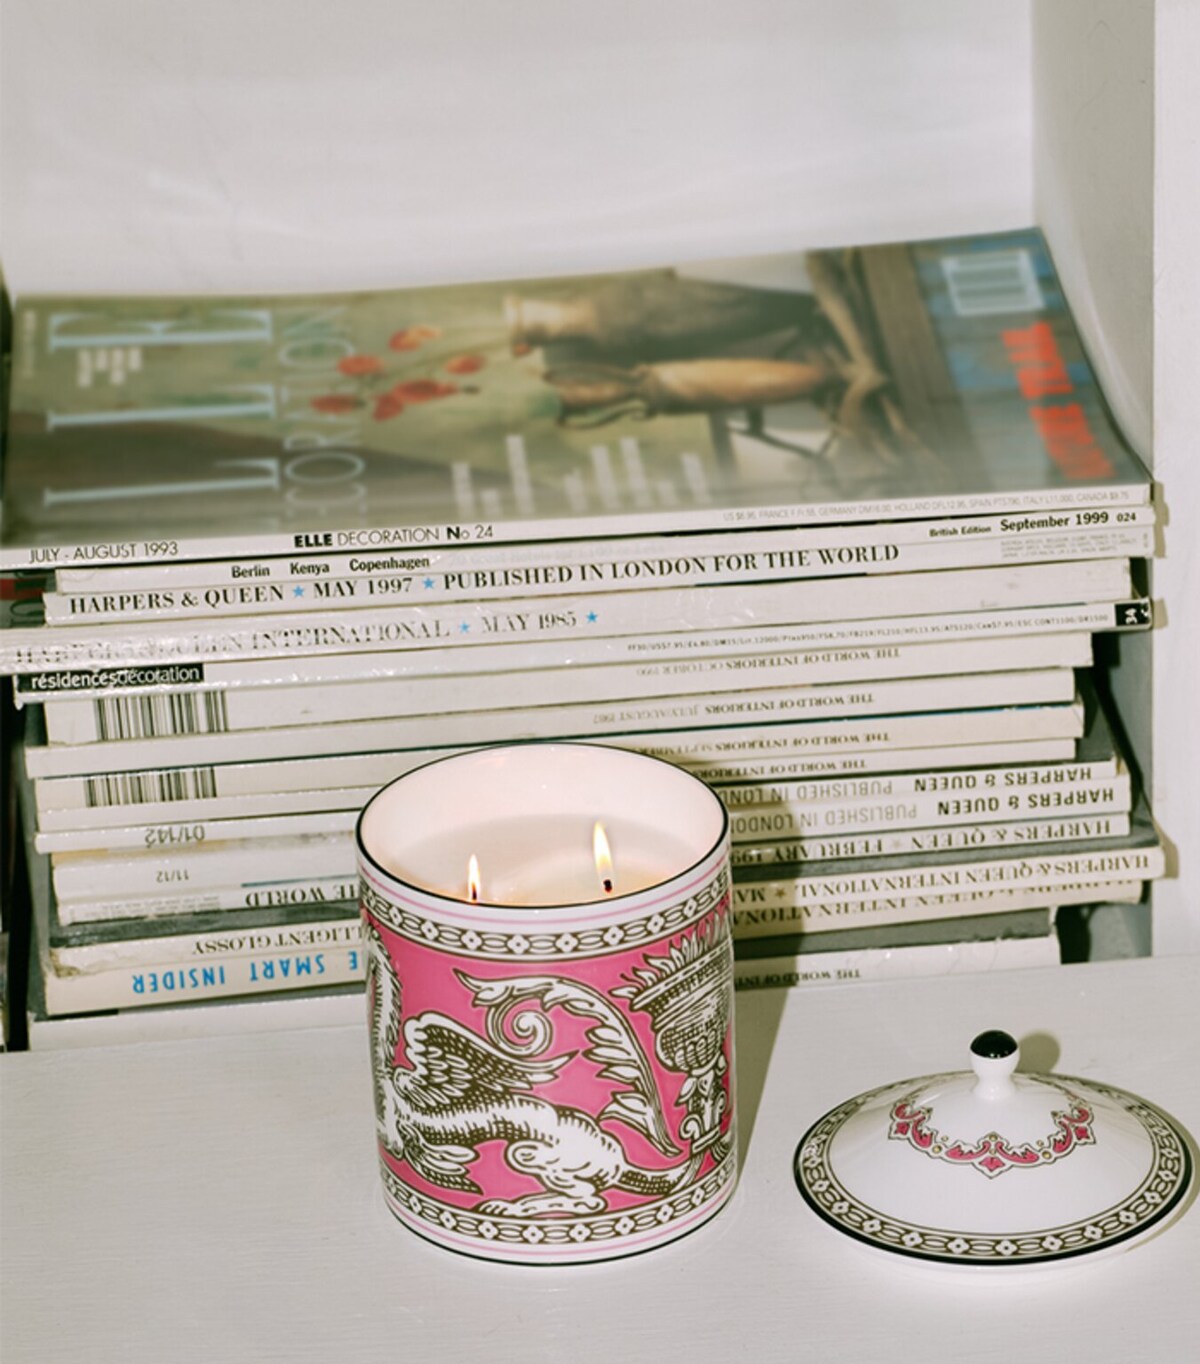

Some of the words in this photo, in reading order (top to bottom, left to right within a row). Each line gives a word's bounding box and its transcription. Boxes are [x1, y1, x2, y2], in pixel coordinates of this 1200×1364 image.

[929, 527, 958, 537] British
[960, 526, 991, 534] Edition
[1000, 515, 1069, 531] September
[1075, 511, 1108, 525] 1999
[1116, 512, 1136, 522] 024
[293, 533, 333, 548] ELLE
[337, 527, 439, 545] DECORATION
[445, 525, 470, 539] No
[474, 525, 493, 539] 24
[28, 546, 60, 563] JULY
[72, 542, 136, 561] AUGUST
[143, 540, 179, 557] 1993
[231, 565, 270, 578] Berlin
[289, 562, 329, 575] Kenya
[349, 556, 429, 572] Copenhagen
[70, 592, 175, 613] HARPERS
[180, 592, 198, 607] &
[204, 584, 283, 608] QUEEN
[314, 580, 356, 597] MAY
[368, 577, 413, 594] 1997
[443, 565, 573, 589] PUBLISHED
[580, 563, 603, 580] IN
[611, 556, 705, 578] LONDON
[713, 552, 760, 572] FOR
[763, 549, 809, 568] THE
[817, 543, 899, 564] WORLD
[251, 621, 450, 649] INTERNATIONAL
[482, 613, 527, 632] MAY
[538, 610, 577, 629] 1985
[725, 655, 798, 669] INTERIORS
[801, 654, 819, 664] OF
[821, 649, 870, 662] WORLD
[873, 648, 899, 659] THE
[704, 700, 774, 714] INTERIORS
[777, 699, 794, 709] OF
[796, 695, 844, 707] WORLD
[847, 693, 872, 704] THE
[714, 738, 787, 751] INTERIORS
[791, 737, 808, 746] OF
[810, 733, 859, 745] WORLD
[863, 732, 888, 742] THE
[768, 764, 785, 774] OF
[787, 761, 836, 772] WORLD
[840, 759, 865, 769] THE
[914, 775, 976, 791] QUEEN
[984, 774, 995, 786] &
[1004, 767, 1091, 786] HARPERS
[770, 786, 789, 803] IN
[795, 779, 892, 801] PUBLISHED
[1027, 788, 1113, 808] HARPERS
[938, 796, 999, 815] QUEEN
[1008, 795, 1018, 809] &
[798, 811, 816, 829] IN
[824, 803, 917, 826] PUBLISHED
[995, 828, 1008, 841] &
[1013, 820, 1110, 841] HARPERS
[911, 830, 986, 849] QUEEN
[772, 838, 882, 862] FEBRUARY
[154, 868, 190, 884] 11/12
[793, 870, 960, 898] INTERNATIONAL
[244, 884, 326, 908] WORLD
[192, 934, 272, 956] GLOSSY
[248, 952, 324, 982] SMART
[130, 964, 226, 994] INSIDER
